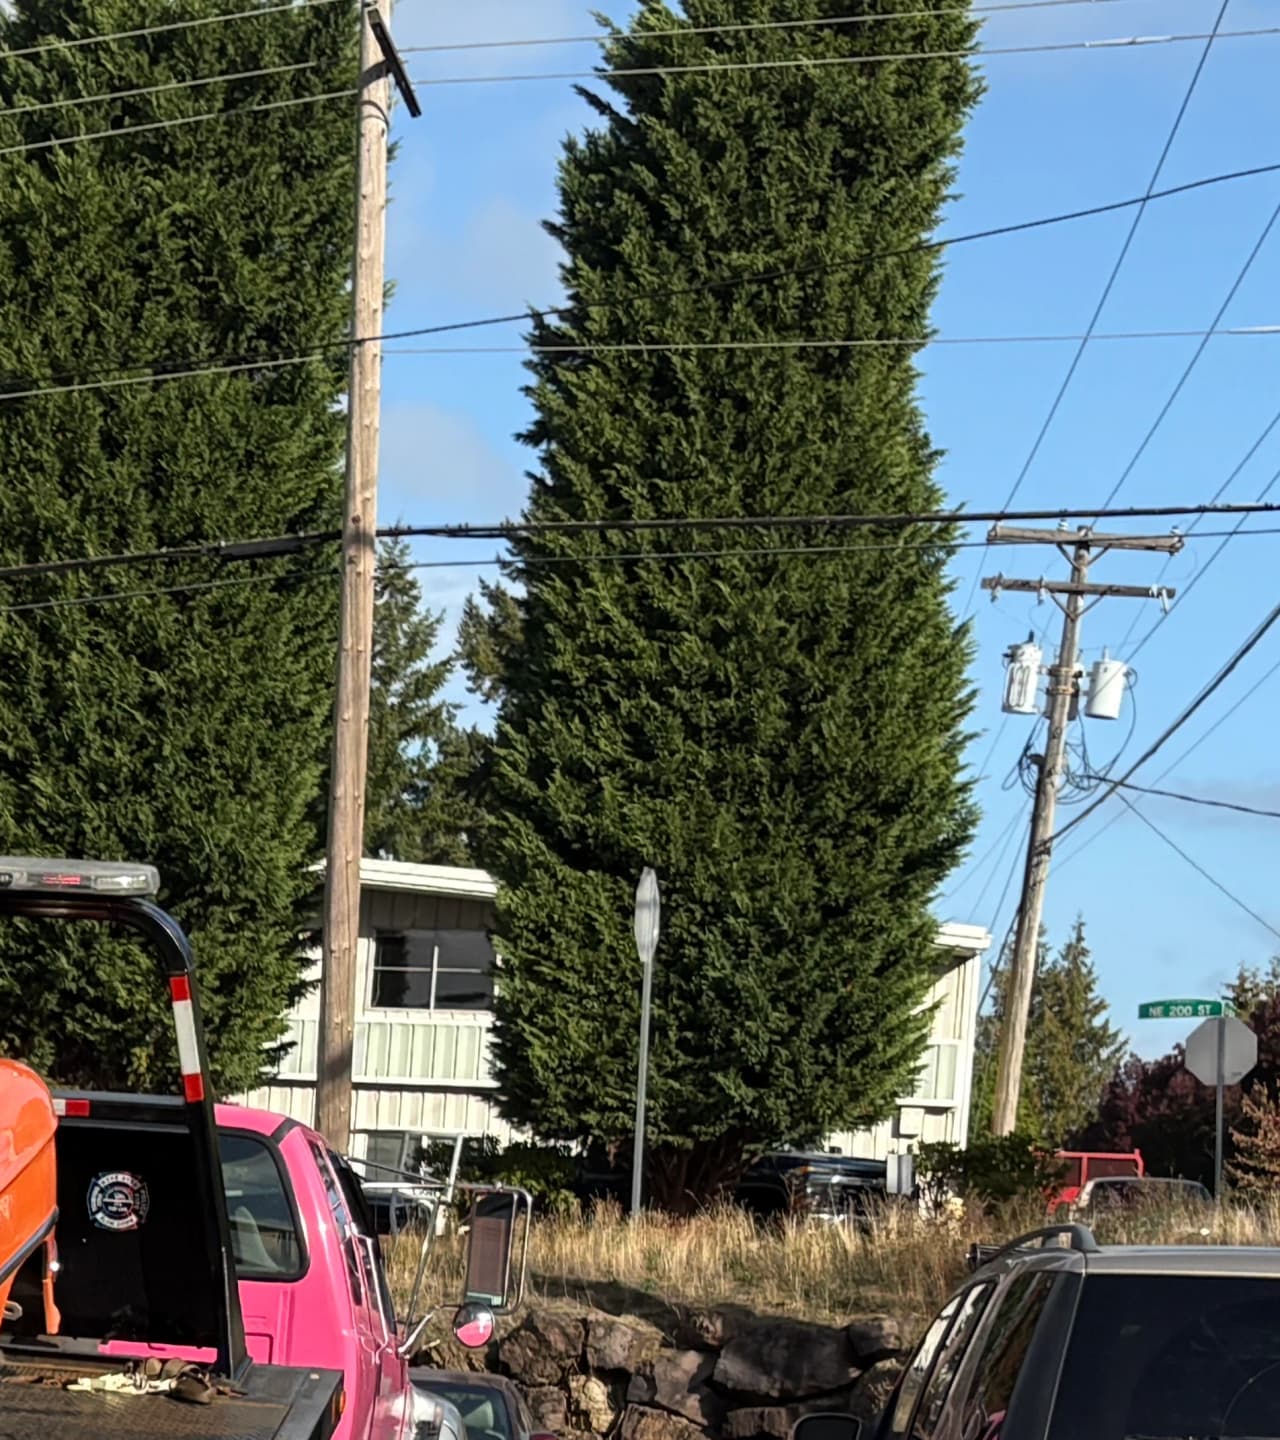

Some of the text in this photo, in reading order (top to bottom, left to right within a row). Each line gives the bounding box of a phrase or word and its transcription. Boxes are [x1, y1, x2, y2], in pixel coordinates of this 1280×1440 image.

[1149, 1006, 1164, 1016] NE
[1169, 1005, 1192, 1017] 200
[1198, 1005, 1211, 1016] ST
